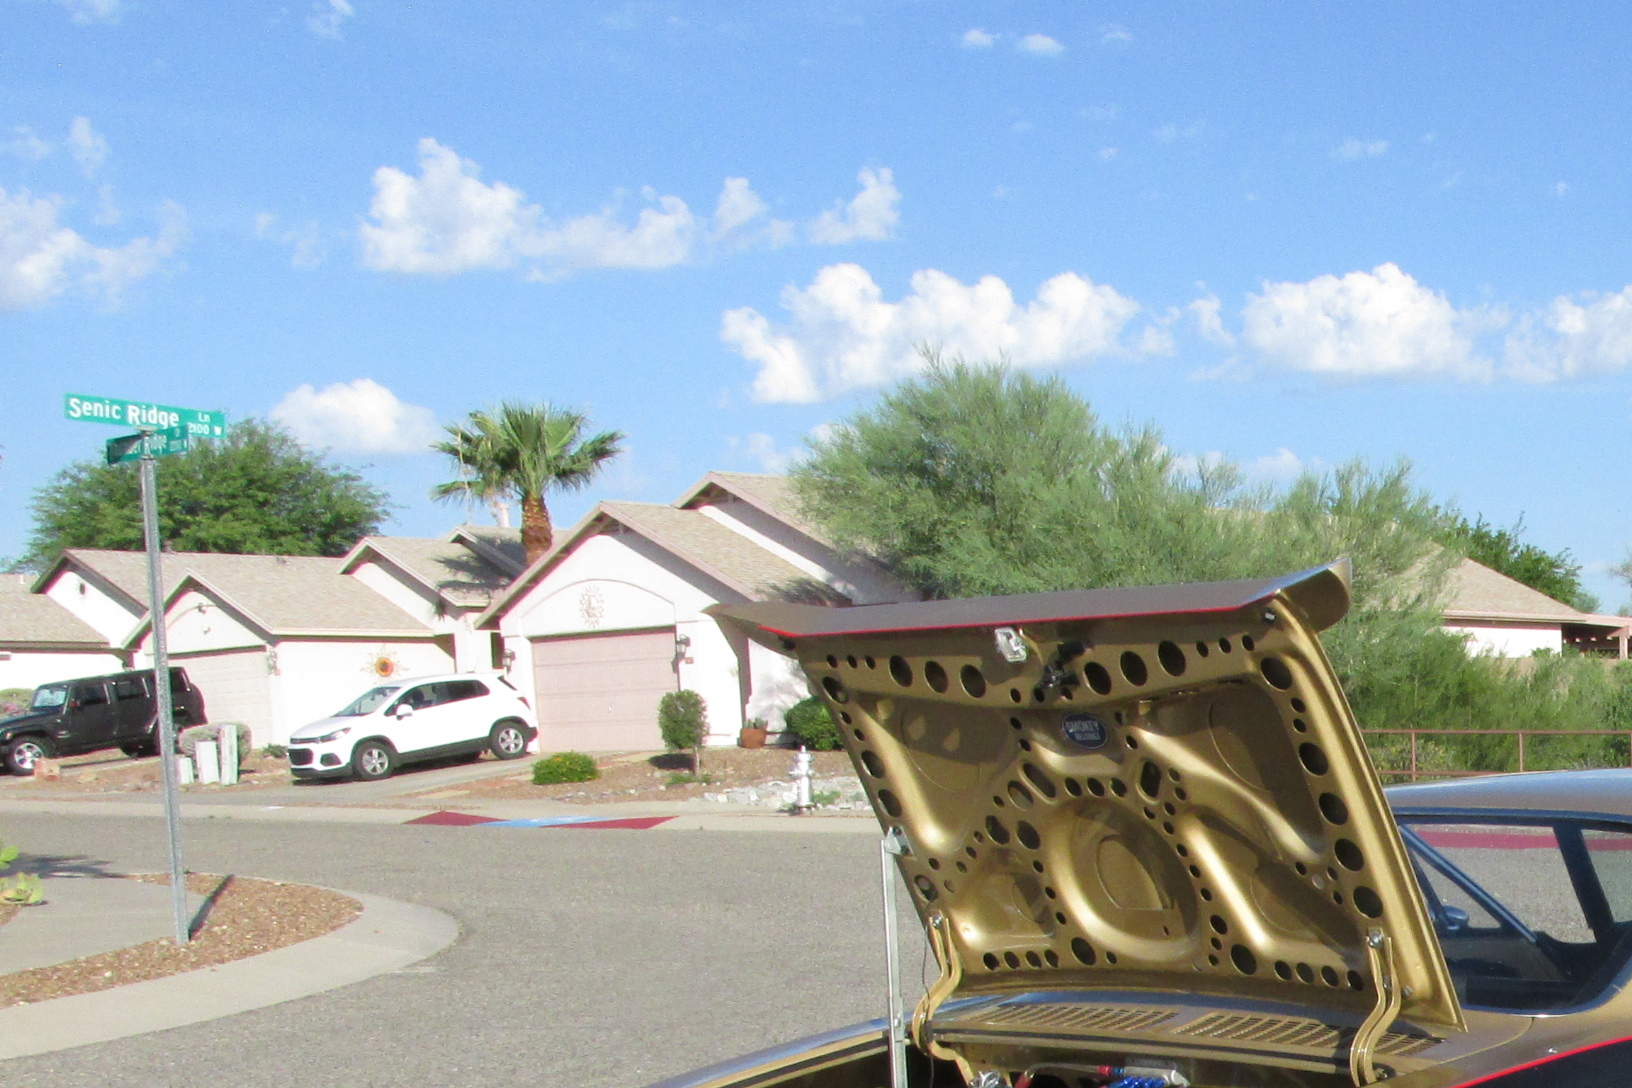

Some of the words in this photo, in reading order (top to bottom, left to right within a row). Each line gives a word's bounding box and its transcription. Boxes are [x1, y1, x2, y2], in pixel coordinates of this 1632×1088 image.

[68, 397, 122, 420] Senic
[127, 404, 180, 429] Ridge
[198, 412, 211, 424] Ln
[188, 421, 210, 435] 2100
